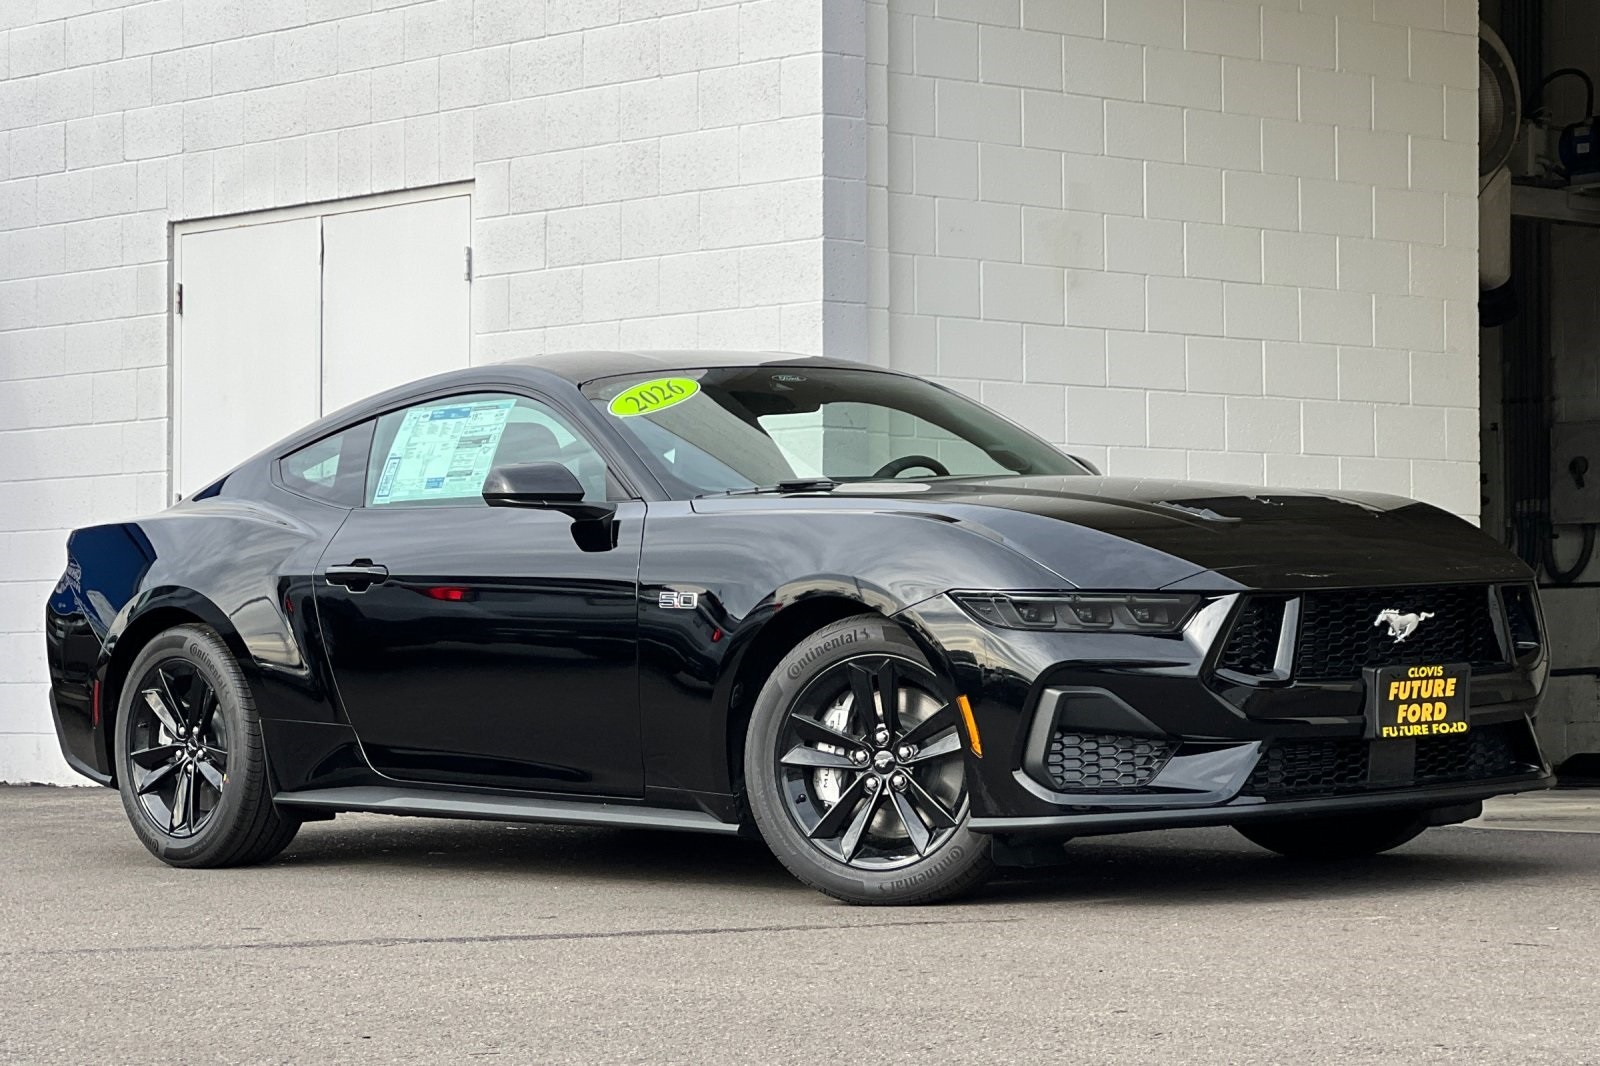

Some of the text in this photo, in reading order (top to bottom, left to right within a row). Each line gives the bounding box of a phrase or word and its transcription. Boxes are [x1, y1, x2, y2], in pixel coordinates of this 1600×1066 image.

[625, 380, 685, 412] 2026
[659, 591, 698, 609] 5.0
[787, 629, 859, 680] Continental
[1407, 665, 1444, 678] CLOVIS
[1388, 678, 1457, 701] FUTURE
[1397, 701, 1447, 724] FORD
